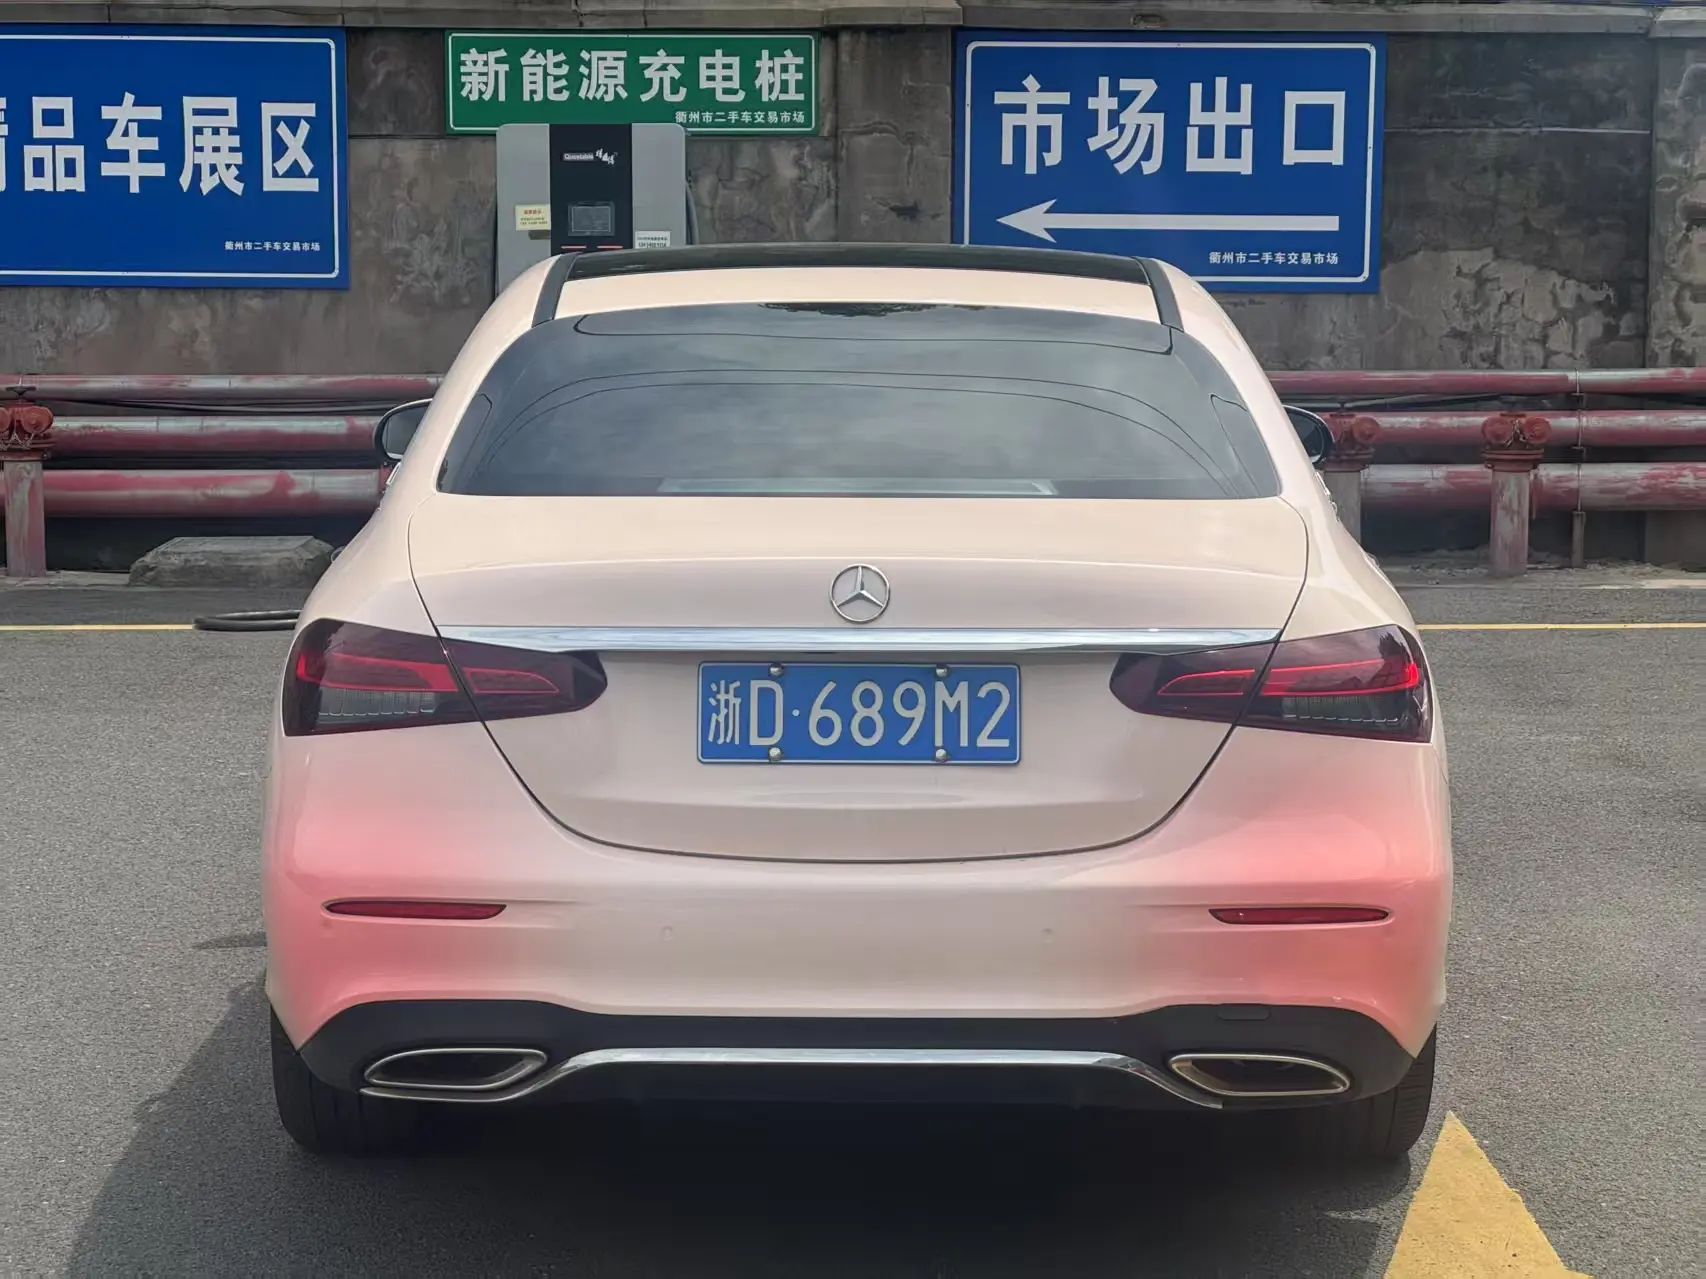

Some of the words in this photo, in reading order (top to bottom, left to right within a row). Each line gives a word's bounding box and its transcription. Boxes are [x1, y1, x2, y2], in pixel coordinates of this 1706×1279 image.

[461, 48, 805, 102] 新能源充电桩
[0, 92, 318, 196] 品车展区
[674, 111, 805, 124] 衢州市二手车交易市场
[995, 75, 1346, 175] 市场出口
[224, 241, 320, 251] 衢州市二手车交易市场
[1209, 251, 1338, 265] 衢州市二手车交易市场
[708, 680, 1011, 747] 浙D·689M2
